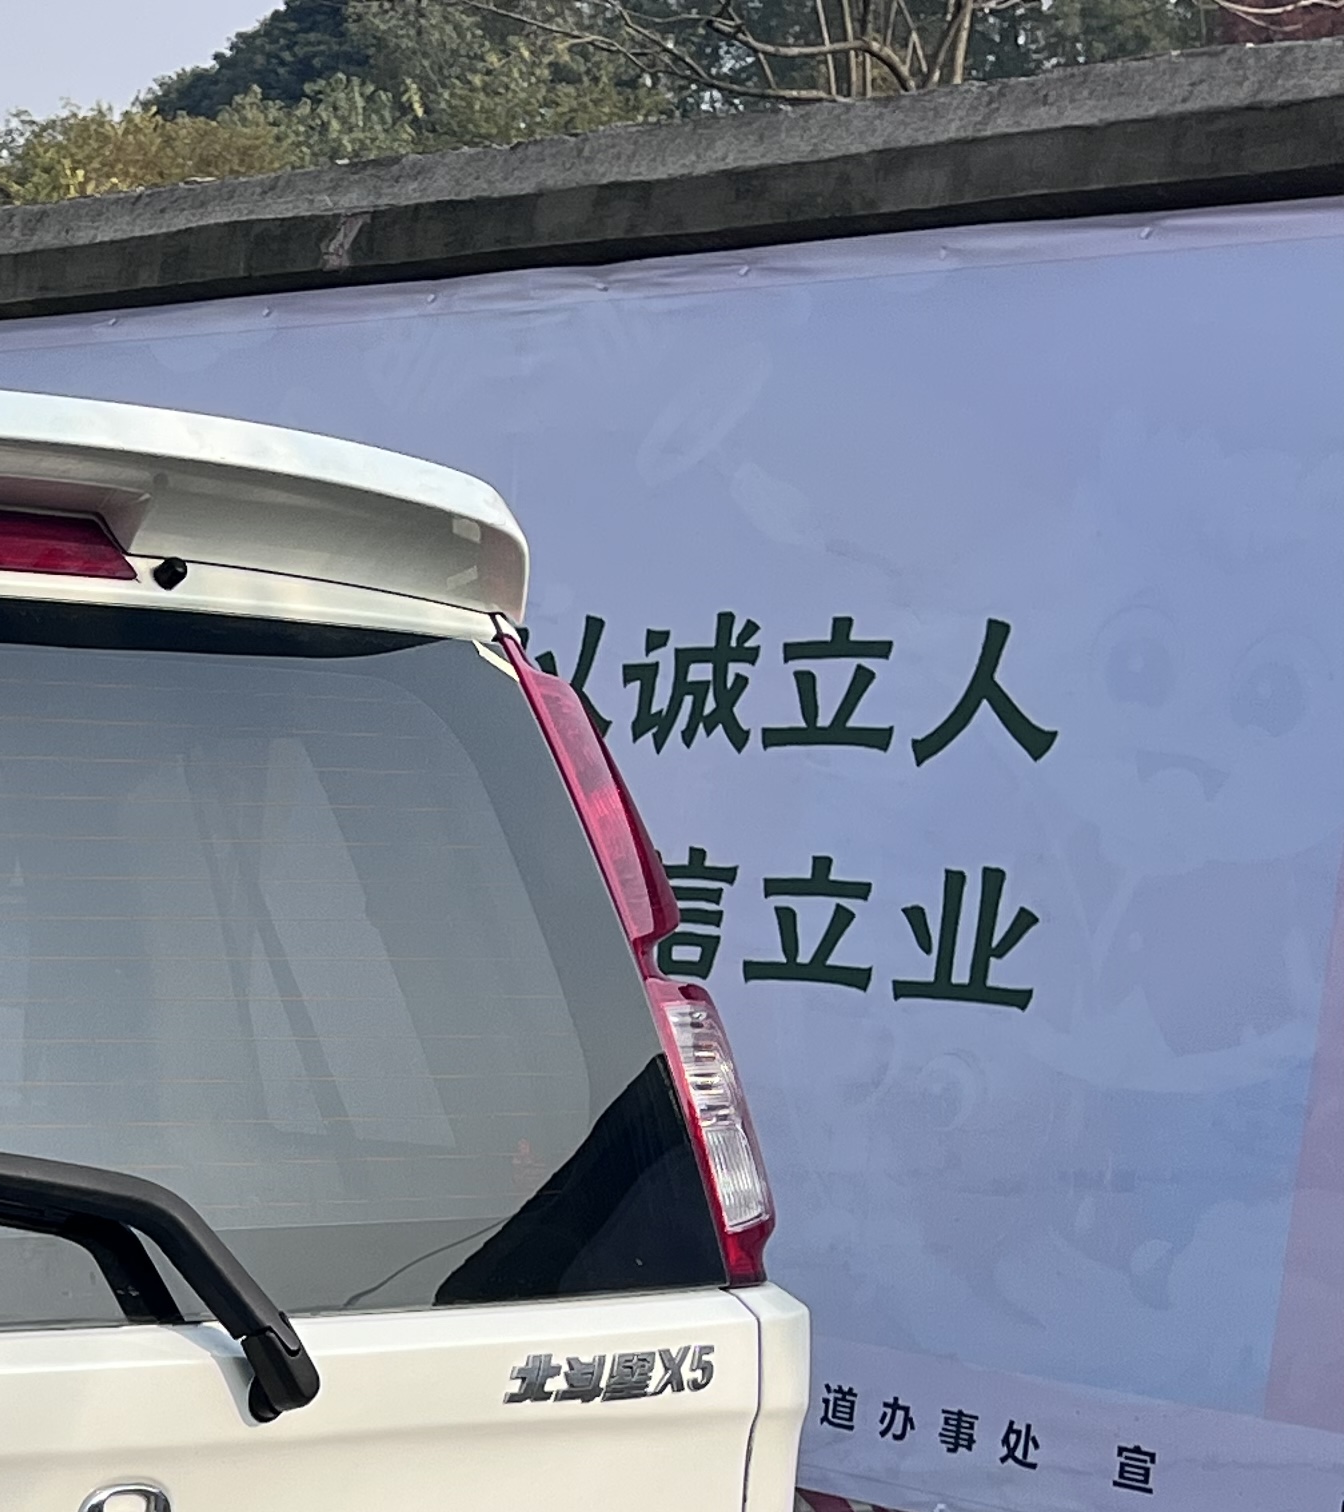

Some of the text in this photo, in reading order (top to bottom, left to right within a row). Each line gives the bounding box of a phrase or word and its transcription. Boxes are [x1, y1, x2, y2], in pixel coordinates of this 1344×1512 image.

[819, 1382, 1158, 1494] 道办事处 宣
